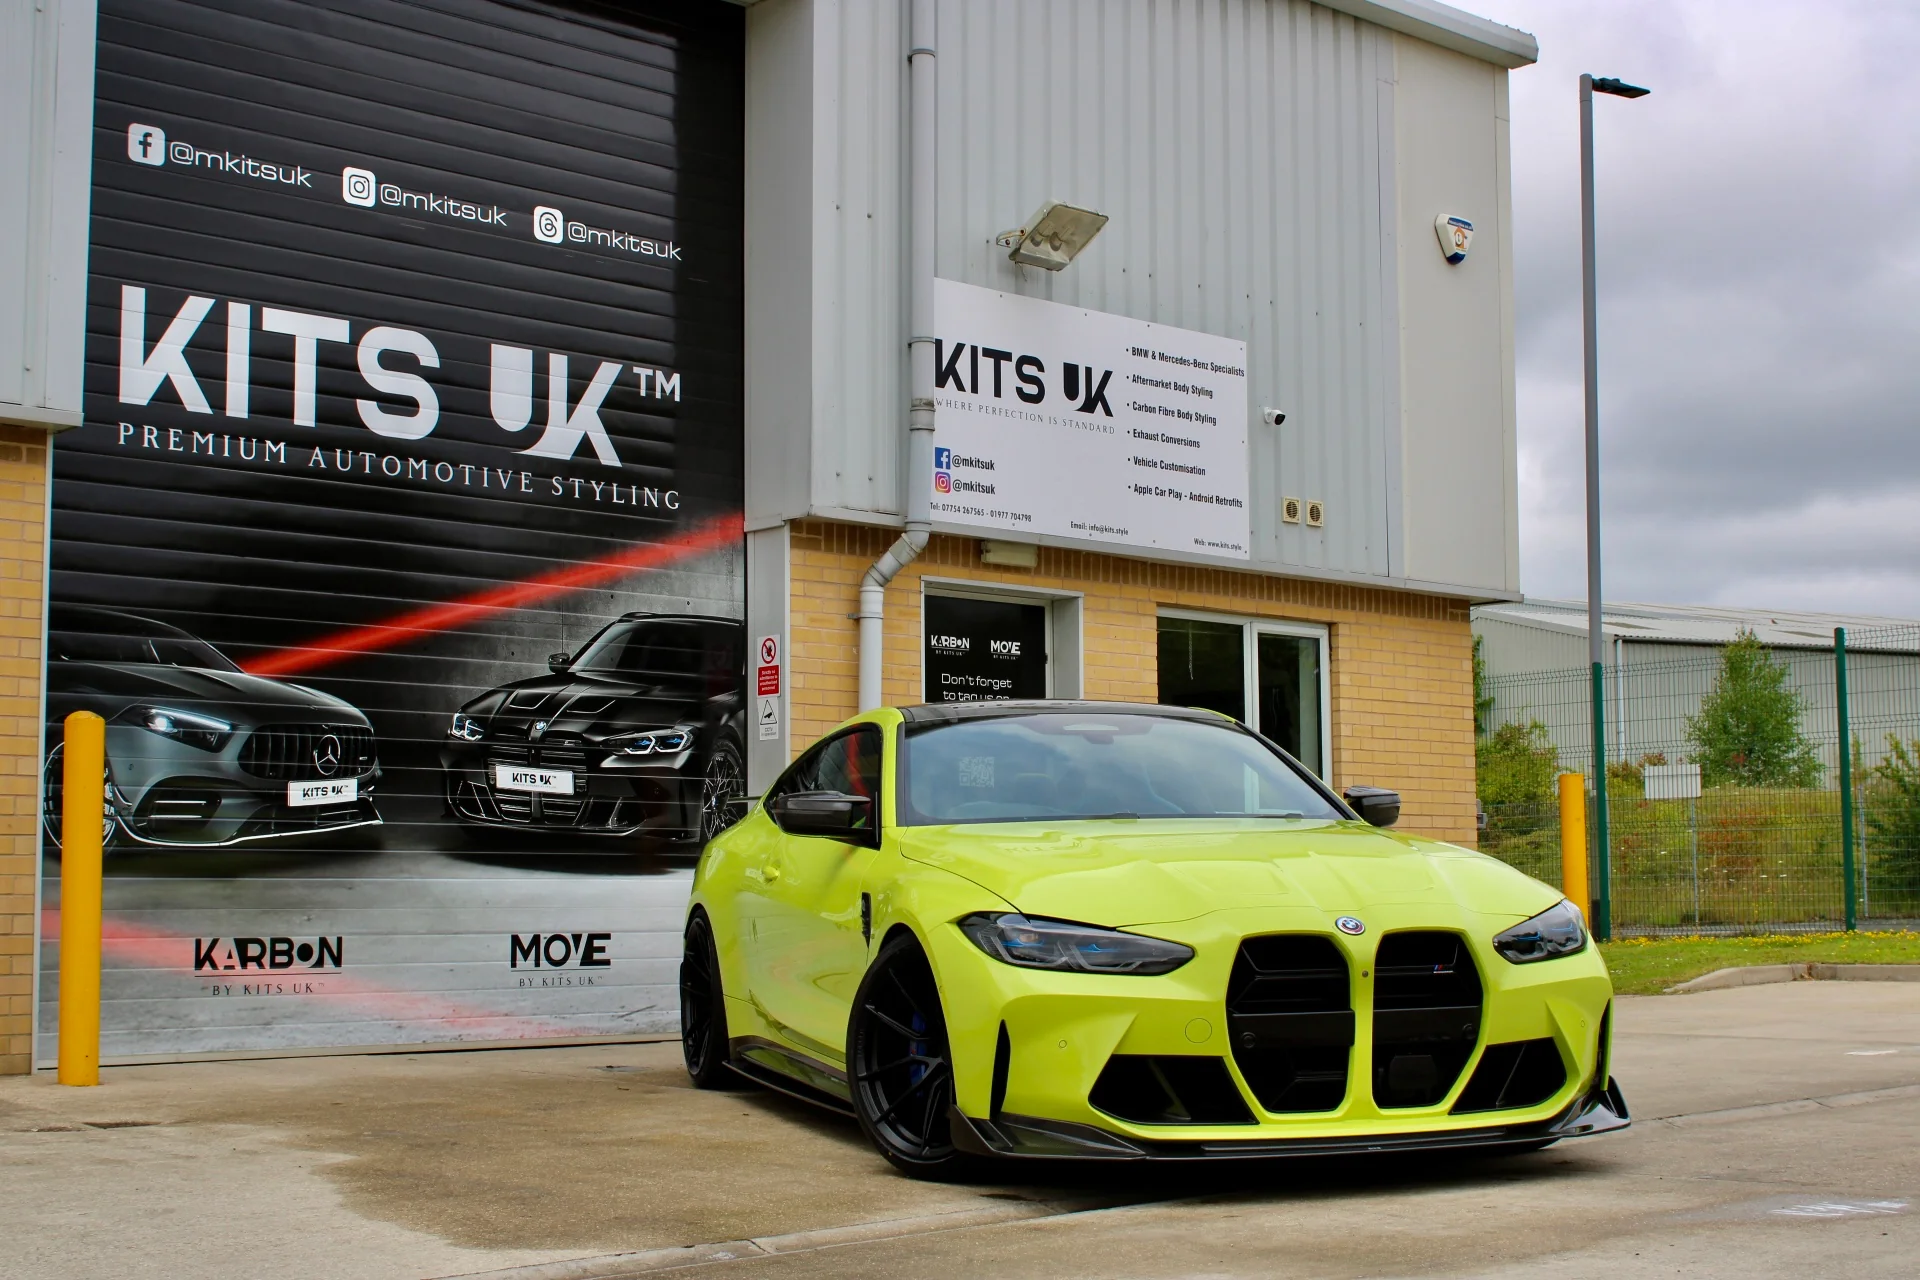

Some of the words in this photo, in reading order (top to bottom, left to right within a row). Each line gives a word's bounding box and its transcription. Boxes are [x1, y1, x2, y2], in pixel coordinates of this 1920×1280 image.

[170, 141, 312, 188] @mkitsuk
[380, 183, 508, 227] @mkitsuk
[567, 221, 682, 261] @mkitsuk
[118, 284, 440, 440] KITS
[1131, 346, 1149, 359] BMW
[1151, 351, 1157, 360] &
[1158, 352, 1208, 370] Mercedes-Benz
[1210, 362, 1245, 377] Specialists
[934, 338, 1045, 404] KITS
[1063, 362, 1114, 417] UK
[1132, 374, 1172, 390] Aftermarket
[1173, 382, 1189, 395] Body
[1191, 385, 1213, 399] Styling
[935, 397, 973, 411] WHERE
[978, 404, 1044, 423] PERFECTION
[1048, 416, 1058, 425] IS
[1062, 419, 1115, 435] STANDARD
[1132, 401, 1156, 414] Carbon
[1158, 405, 1175, 417] Fibre
[1177, 409, 1193, 422] Body
[1194, 412, 1217, 426] Styling
[1133, 428, 1159, 442] Exhaust
[1160, 433, 1200, 448] Conversions
[117, 422, 287, 464] PREMIUM
[308, 446, 534, 493] AUTOMOTIVE
[551, 476, 682, 510] STYLING
[952, 454, 995, 471] @mkitsuk
[1133, 456, 1158, 469] Vehicle
[1159, 460, 1206, 476] Customisation
[952, 479, 996, 495] @mkitsuk
[1133, 484, 1152, 496] Apple
[1154, 486, 1166, 497] Car
[1168, 489, 1182, 501] Play
[1189, 492, 1214, 504] Android
[1215, 495, 1243, 508] Retrofits
[942, 503, 961, 513] 07754
[990, 510, 1009, 520] 01977
[1070, 521, 1088, 530] Email:
[1088, 523, 1129, 536] info@kits.style
[941, 673, 975, 686] Don't
[976, 675, 1012, 690] forget
[943, 690, 956, 700] to
[512, 772, 537, 784] KITS
[302, 786, 329, 798] KITS
[194, 936, 343, 971] KARBON
[510, 933, 611, 968] MOVE
[212, 984, 232, 996] BY
[244, 983, 283, 995] KITS
[519, 977, 534, 987] BY
[542, 976, 572, 987] KITS
